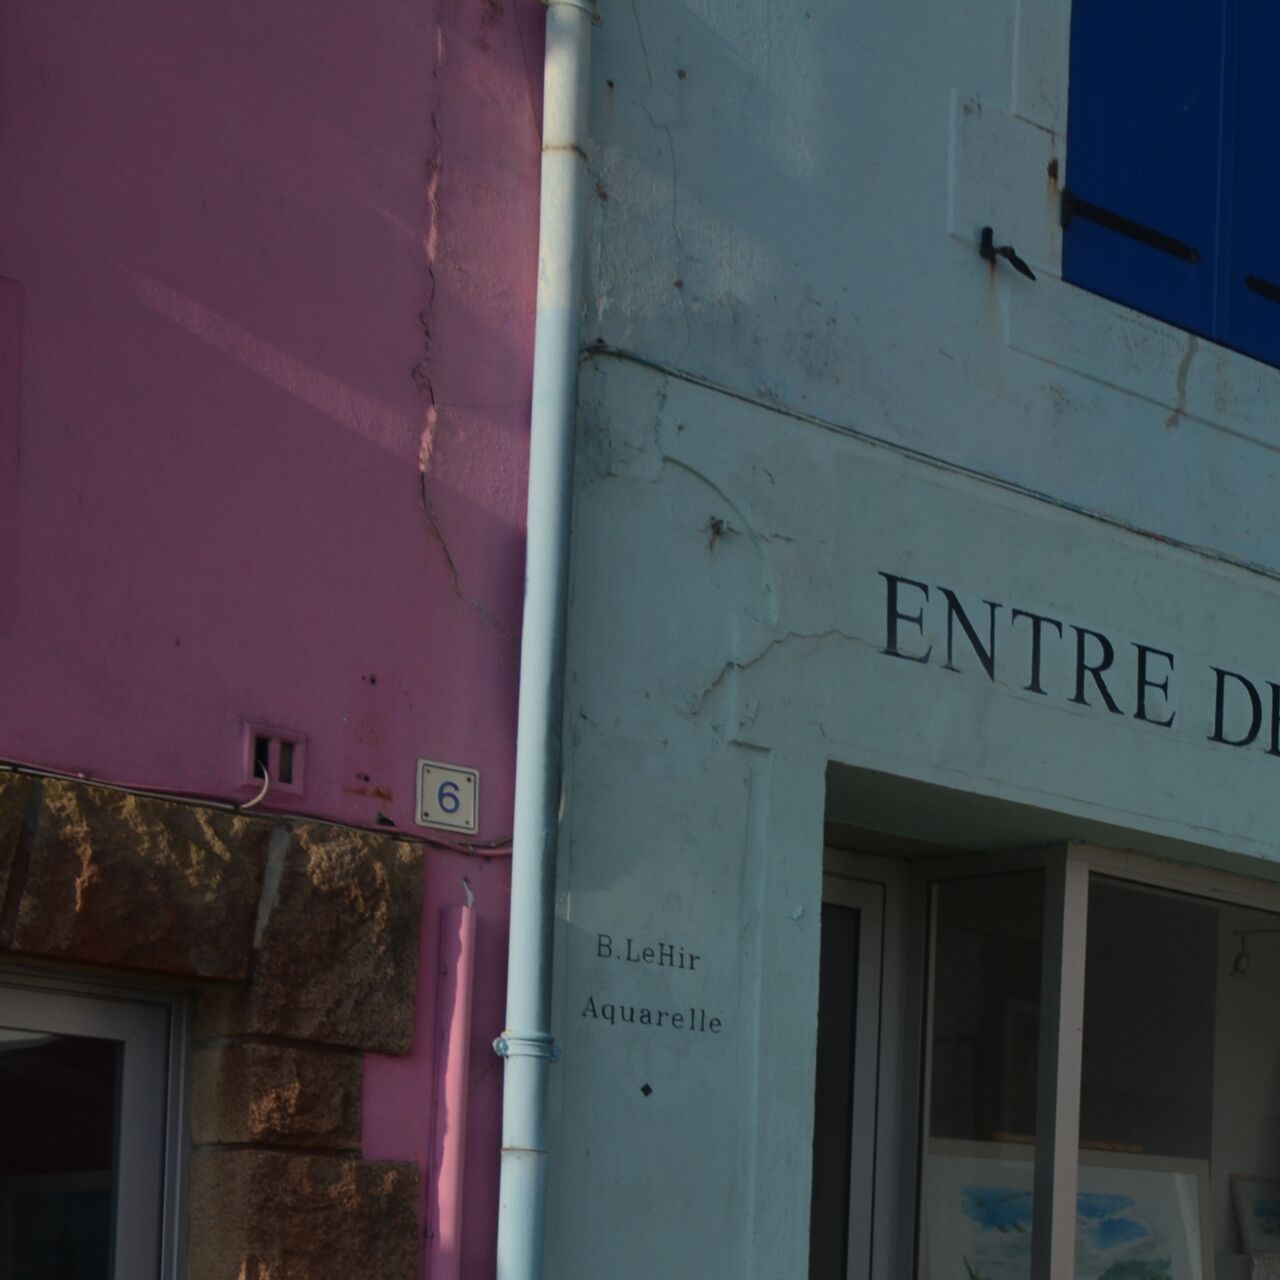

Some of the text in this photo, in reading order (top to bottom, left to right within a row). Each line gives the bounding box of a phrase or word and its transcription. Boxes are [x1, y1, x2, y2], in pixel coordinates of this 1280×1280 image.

[878, 570, 1176, 729] ENTRE
[438, 781, 459, 814] 6
[582, 995, 723, 1035] Aquarelle
